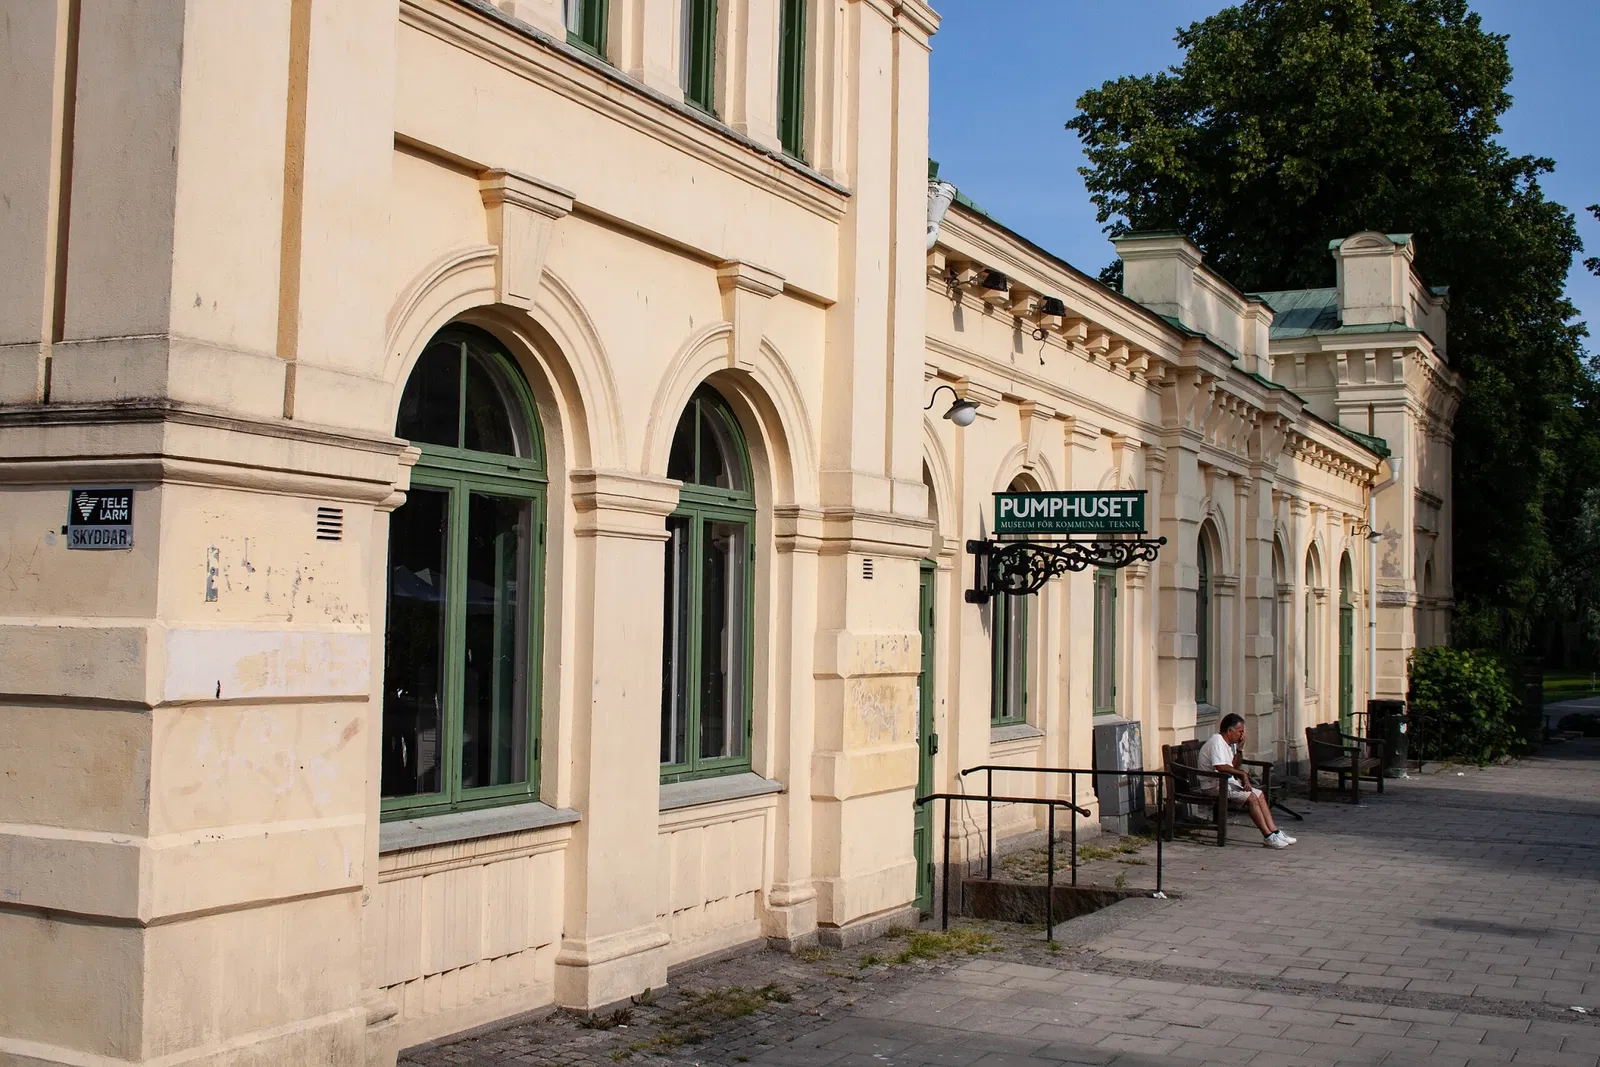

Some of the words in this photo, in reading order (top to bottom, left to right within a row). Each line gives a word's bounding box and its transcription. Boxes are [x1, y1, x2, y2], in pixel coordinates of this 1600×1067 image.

[101, 497, 129, 508] TELE
[1000, 497, 1138, 518] PUMPHUSET
[99, 509, 128, 520] LARM
[1000, 520, 1035, 528] MUSEUM
[1037, 520, 1053, 528] FÖR
[1055, 520, 1104, 528] KOMMUNAL
[1108, 520, 1140, 528] TEKNIK
[72, 529, 128, 545] SKYDDAR
